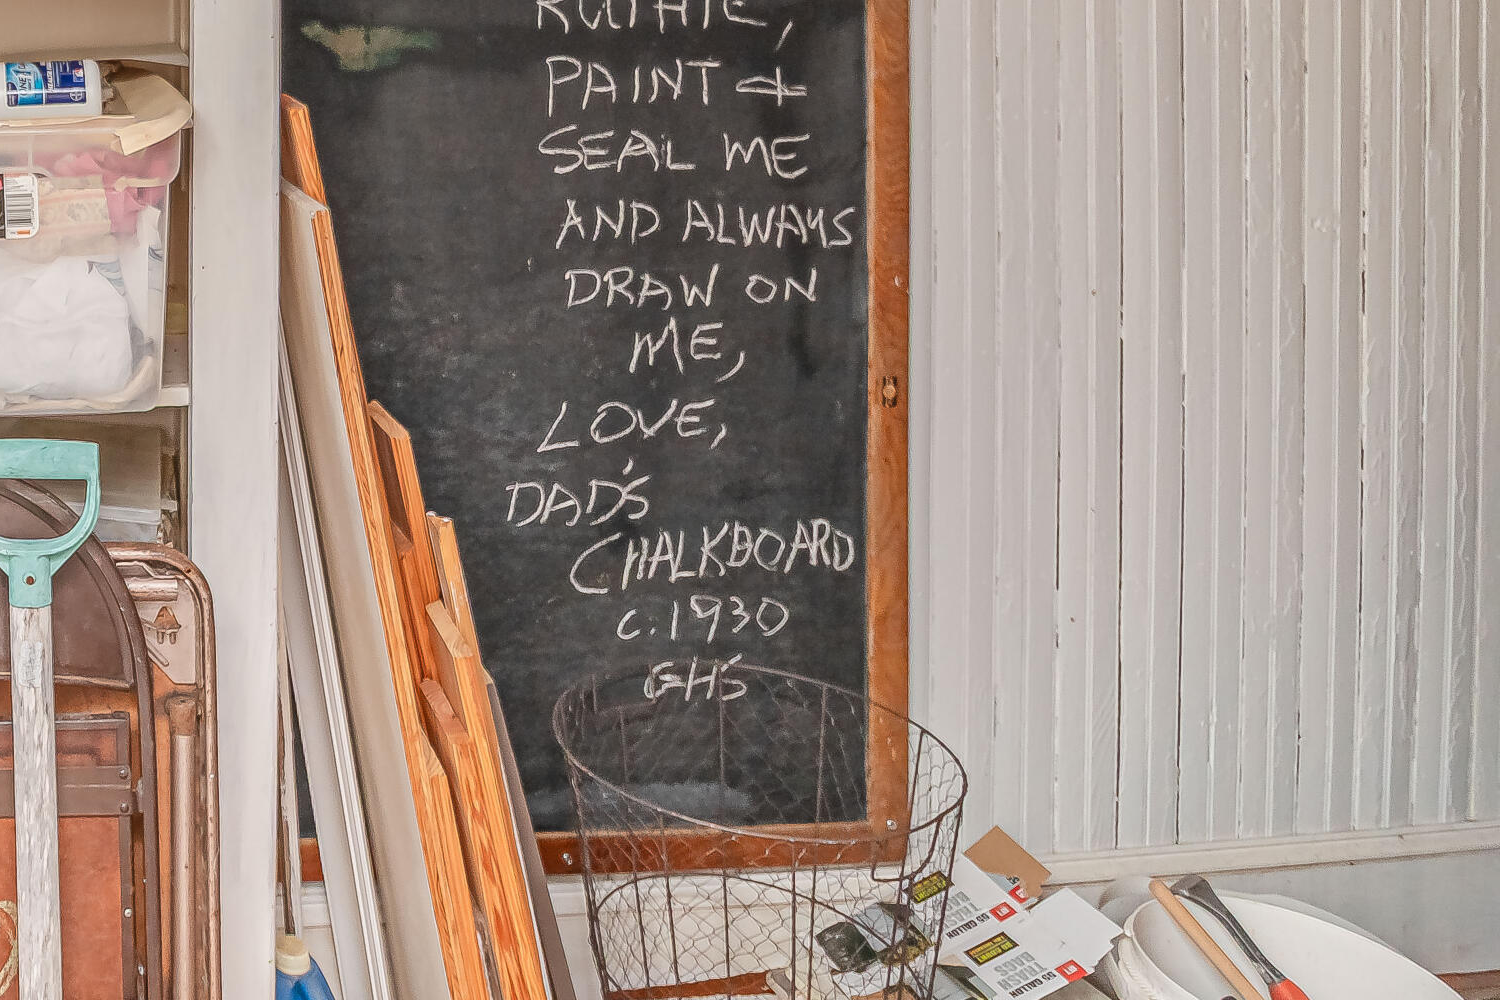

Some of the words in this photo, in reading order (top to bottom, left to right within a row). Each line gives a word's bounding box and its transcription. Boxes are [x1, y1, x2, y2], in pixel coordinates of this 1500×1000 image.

[547, 55, 721, 116] PAINT
[537, 125, 696, 175] SEAL
[724, 133, 810, 179] ME
[555, 200, 661, 249] AND
[682, 200, 857, 249] ALWAYS
[564, 263, 721, 310] DRAW
[745, 267, 818, 306] ON
[628, 316, 746, 382] ME,
[536, 398, 727, 453] LOVE,
[505, 457, 652, 527] DAD'S
[569, 517, 855, 594] CHALKBOARD
[946, 919, 978, 939] GALLON
[994, 951, 1035, 977] BAGS
[997, 961, 1047, 990] TRASH
[1009, 978, 1043, 998] GALLON
